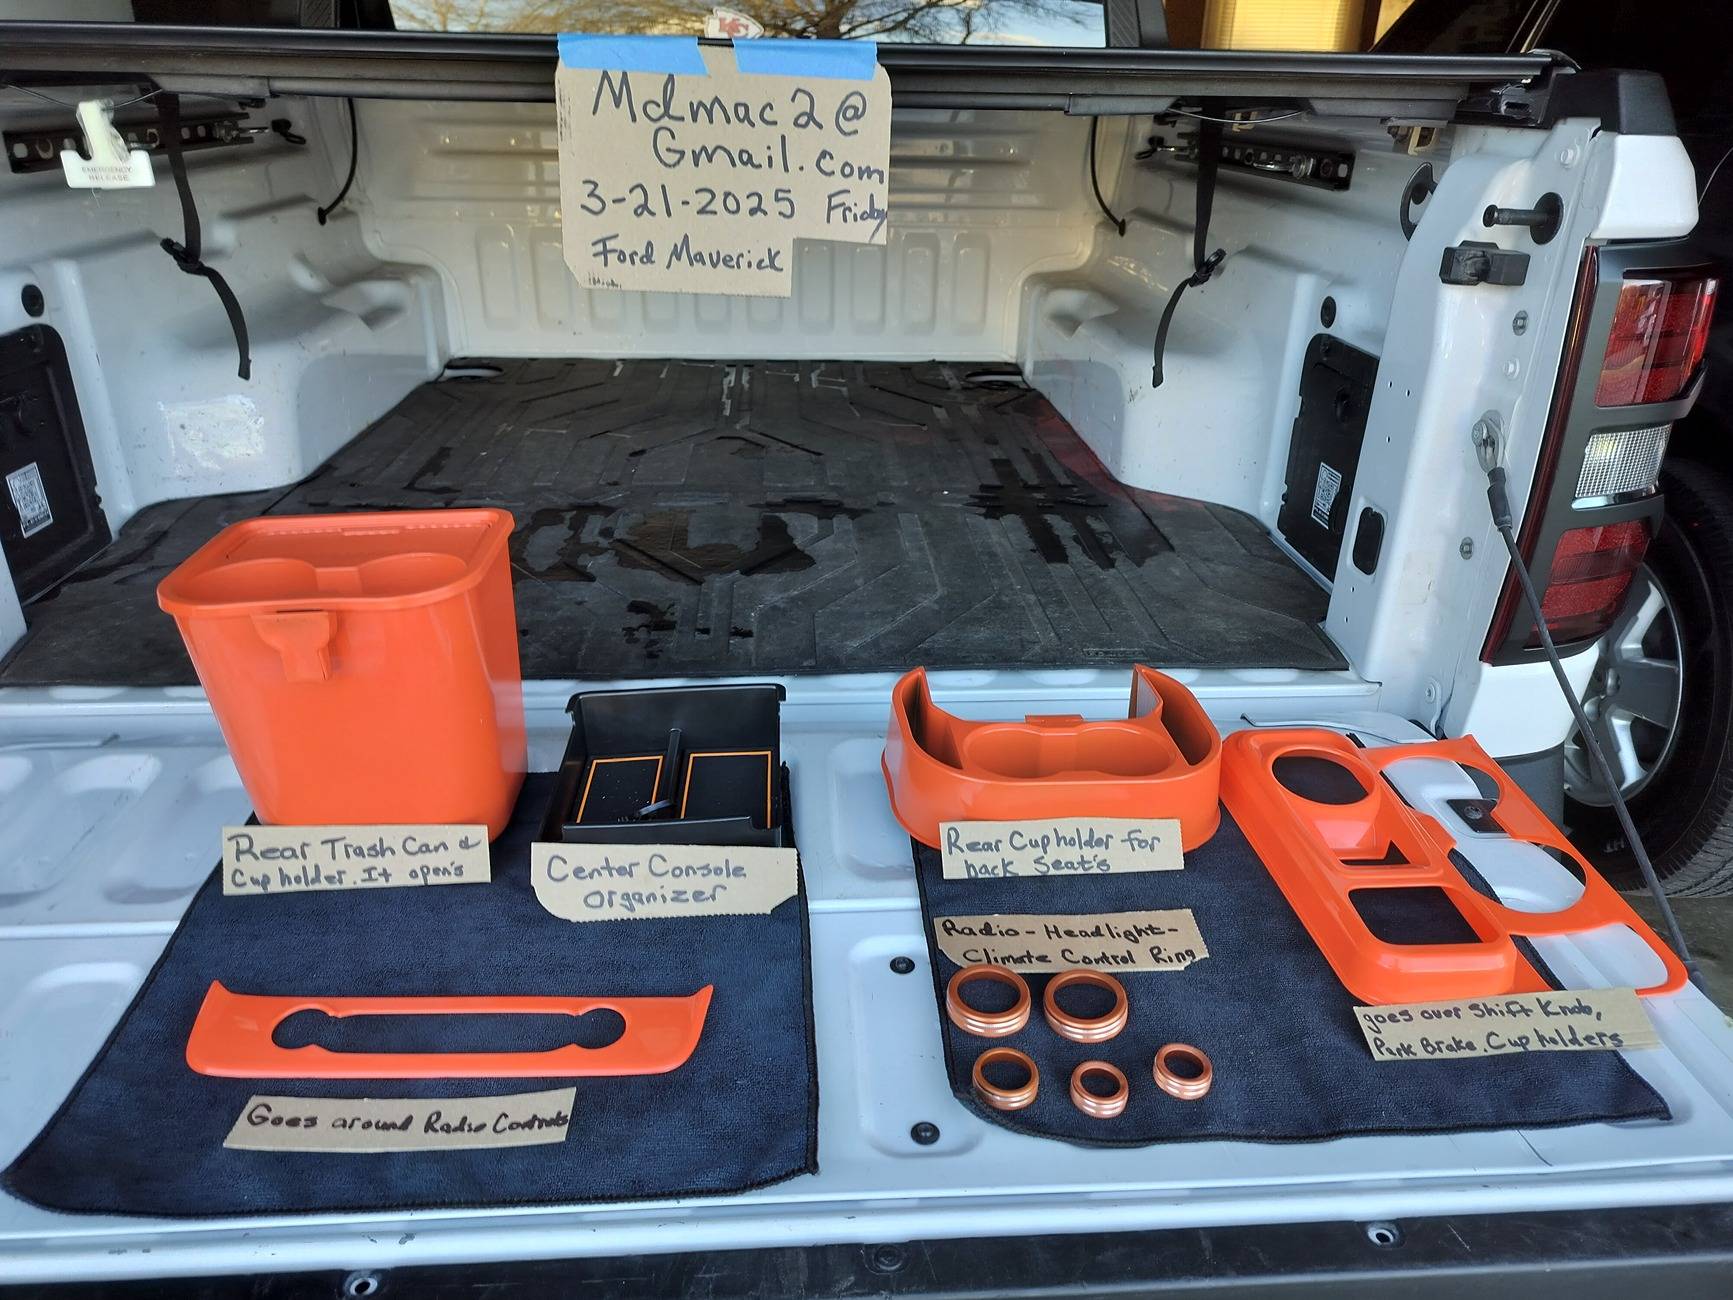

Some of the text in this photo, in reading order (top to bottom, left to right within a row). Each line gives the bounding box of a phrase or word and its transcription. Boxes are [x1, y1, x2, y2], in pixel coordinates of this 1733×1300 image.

[580, 179, 796, 219] 3-21-2025
[591, 233, 784, 272] Ford Maverick
[227, 834, 312, 862] Rear
[321, 836, 397, 861] Trash
[402, 836, 449, 856] Can
[946, 826, 1002, 856] Rear
[361, 866, 392, 883] It
[547, 854, 747, 882] Center Console
[963, 945, 1197, 966] Climate Control Ring
[1420, 1006, 1461, 1020] over
[1468, 1000, 1533, 1020] Shift
[1373, 1037, 1417, 1058] Park
[246, 1104, 318, 1128] Goes
[331, 1115, 413, 1133] around
[423, 1110, 487, 1135] Radio
